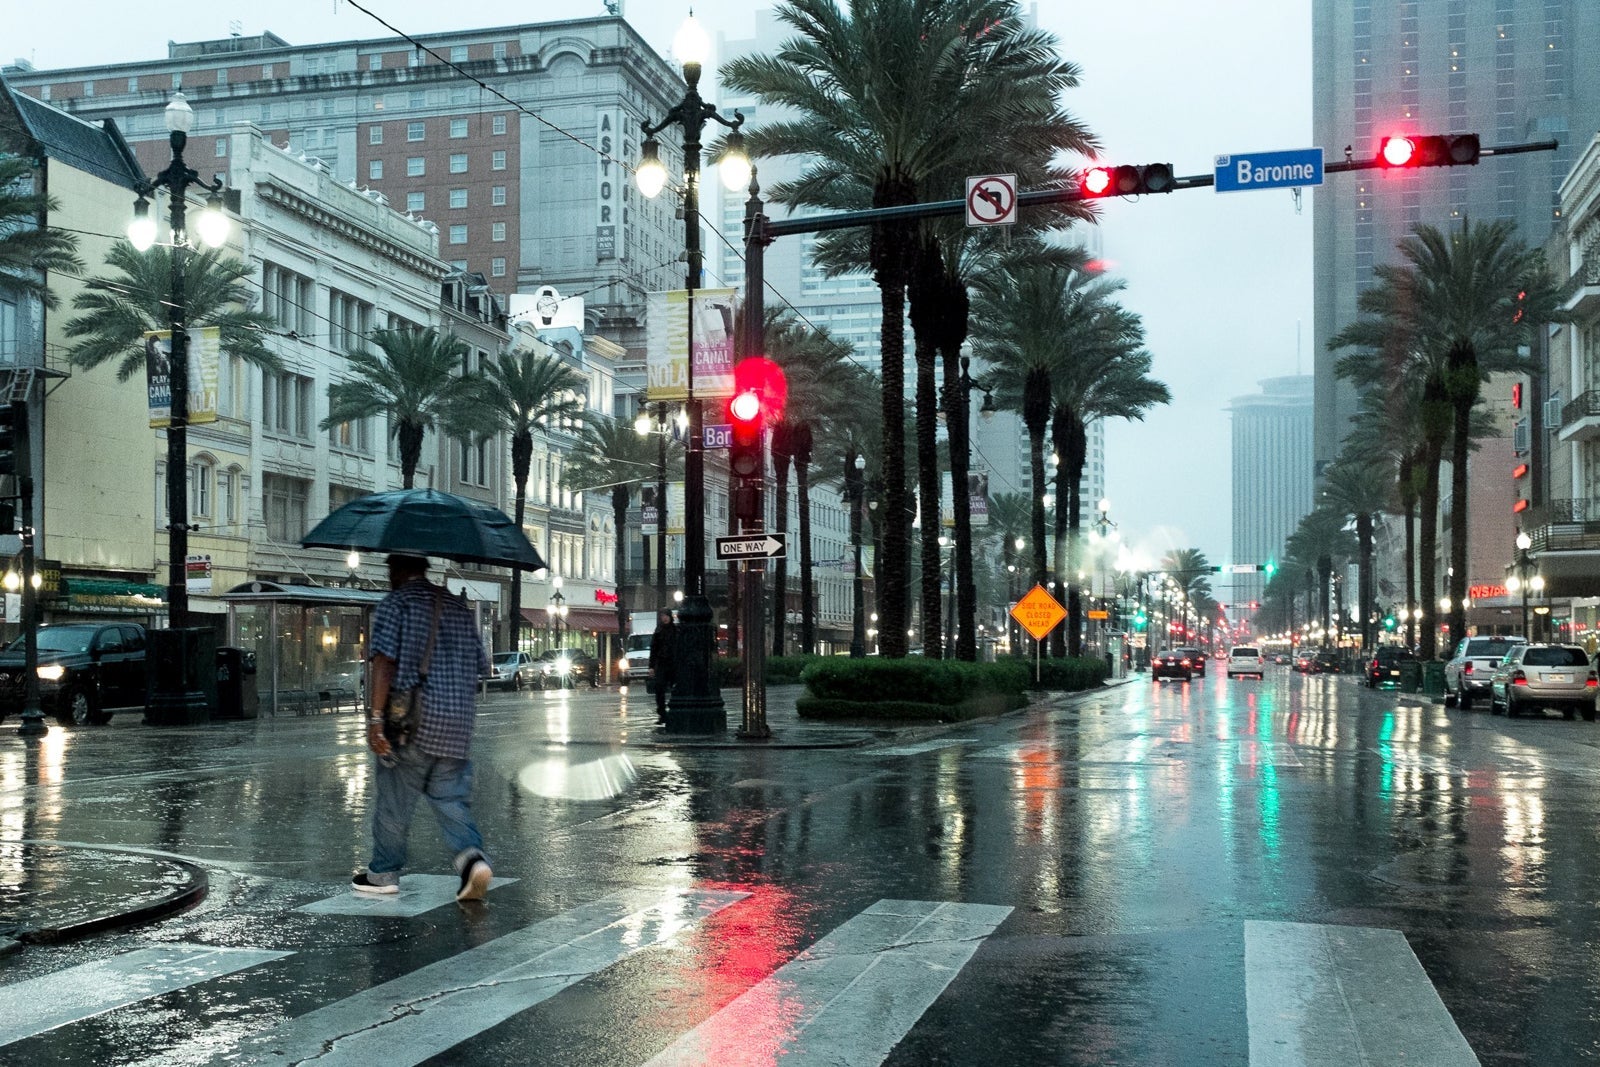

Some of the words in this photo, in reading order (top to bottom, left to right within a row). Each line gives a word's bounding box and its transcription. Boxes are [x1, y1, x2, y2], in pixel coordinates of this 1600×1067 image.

[601, 113, 611, 222] ASTOR
[1237, 159, 1314, 184] Baronne
[695, 350, 731, 365] CANAL
[152, 375, 168, 384] PLAY
[648, 363, 688, 388] NOLA
[149, 386, 171, 398] CANA
[706, 428, 732, 446] Bar
[723, 543, 743, 554] ONE
[745, 541, 765, 552] WAY
[1026, 611, 1051, 619] CLOSED
